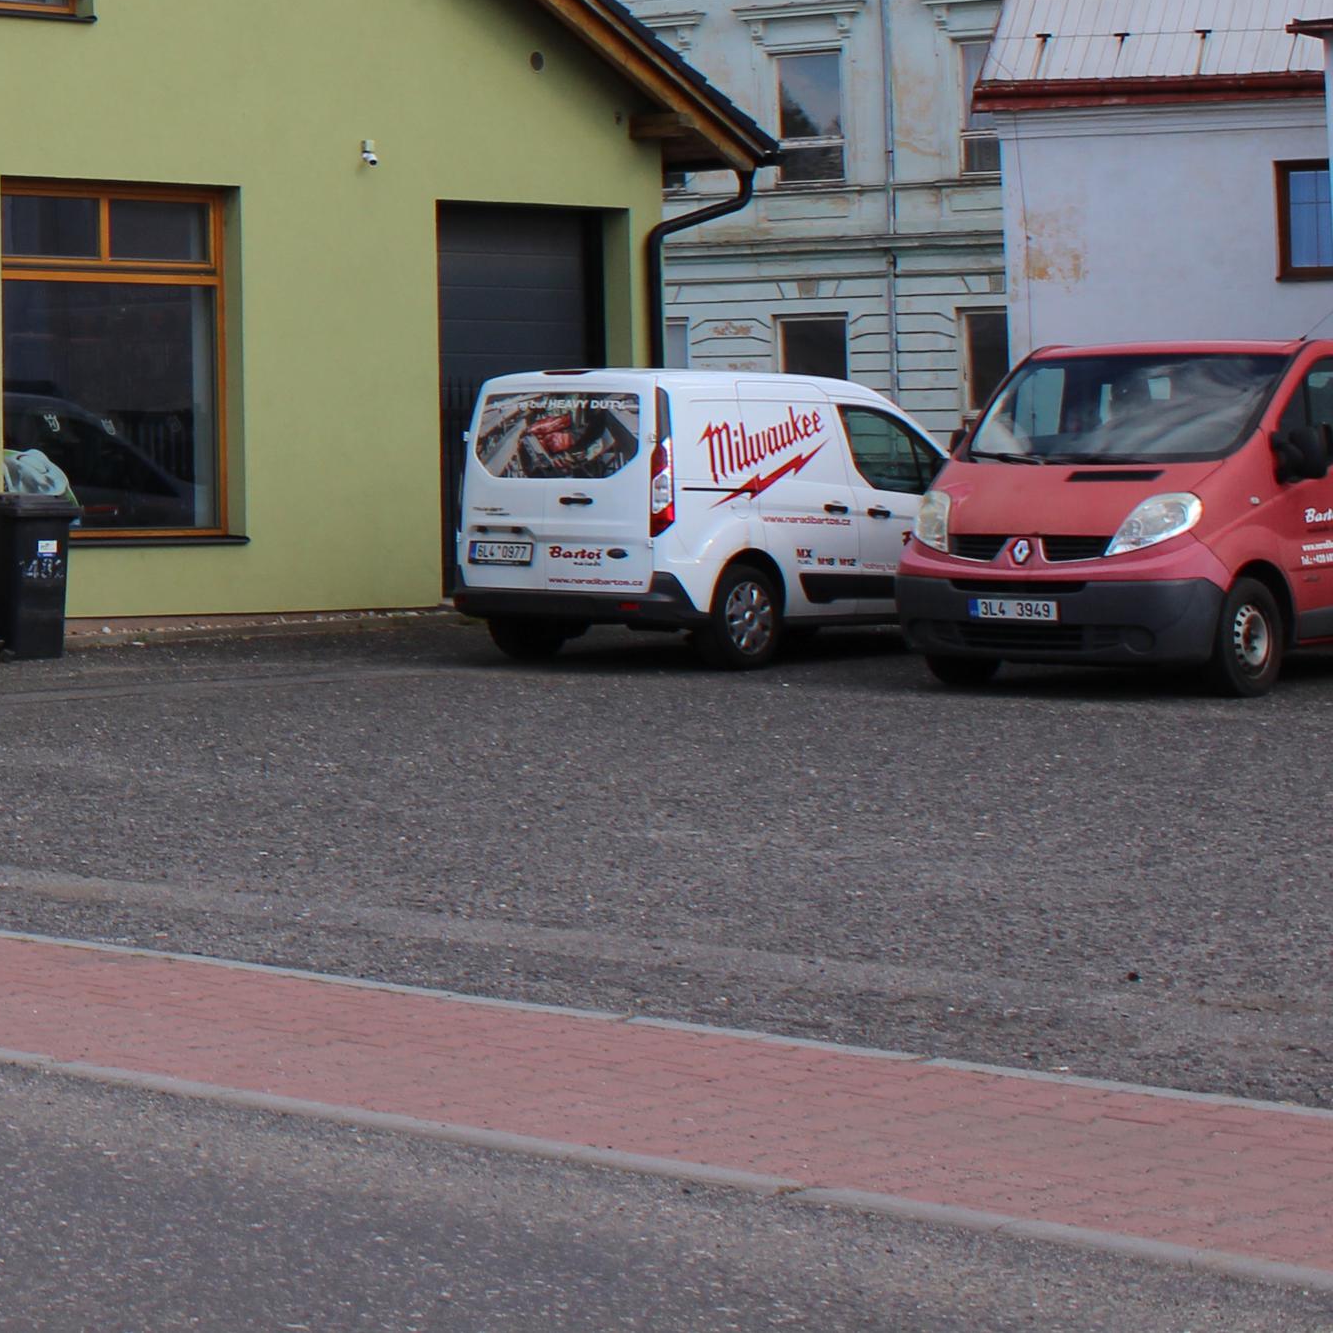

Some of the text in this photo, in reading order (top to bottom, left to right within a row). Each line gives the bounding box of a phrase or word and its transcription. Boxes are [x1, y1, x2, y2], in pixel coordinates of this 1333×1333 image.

[548, 399, 589, 409] HEAVY
[696, 405, 825, 485] Milwaukee
[501, 546, 527, 559] 0977
[548, 545, 603, 560] Bartoš
[796, 548, 813, 559] MX
[839, 557, 856, 566] M12
[981, 601, 1050, 618] 3L4 3949
